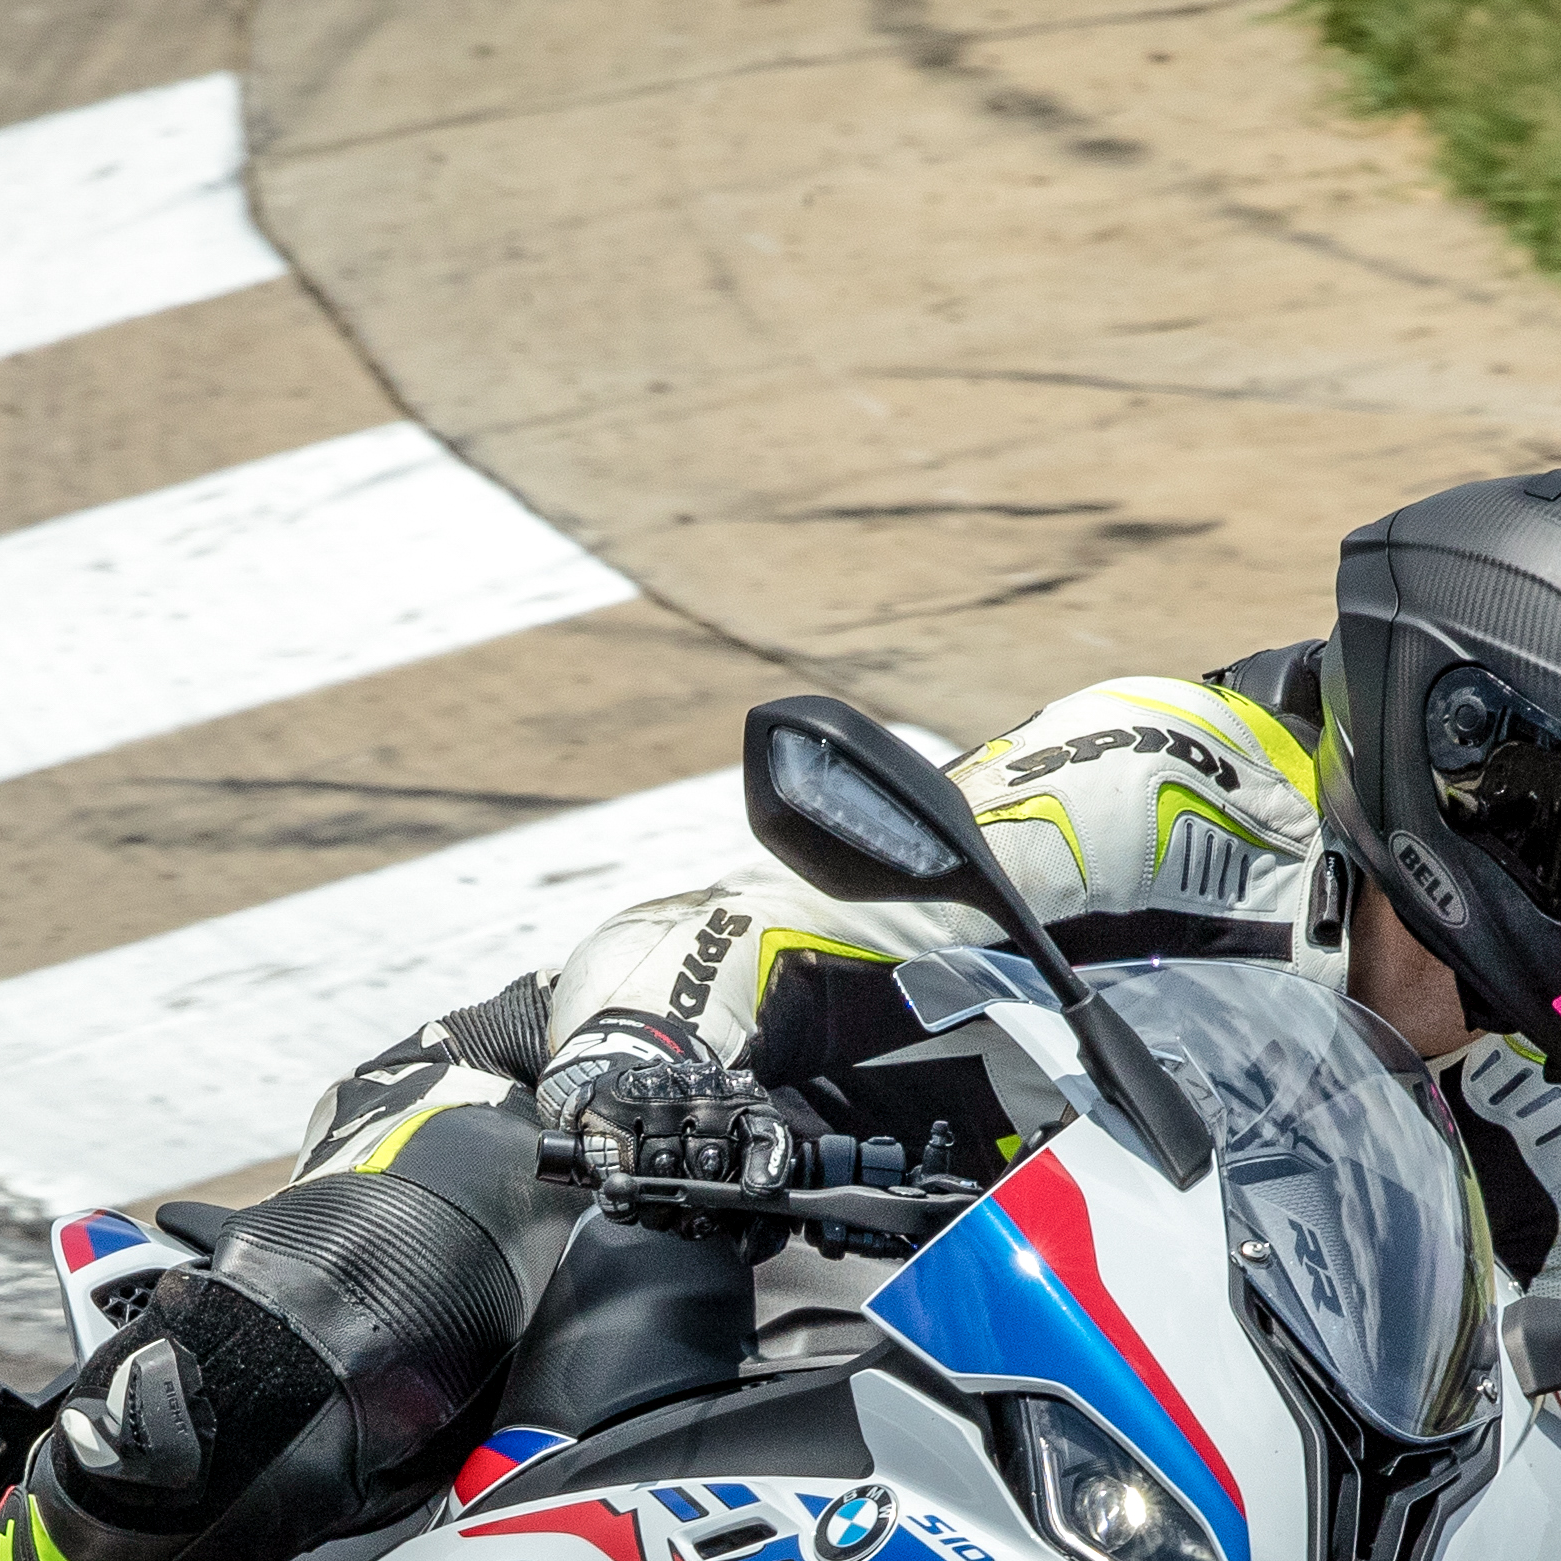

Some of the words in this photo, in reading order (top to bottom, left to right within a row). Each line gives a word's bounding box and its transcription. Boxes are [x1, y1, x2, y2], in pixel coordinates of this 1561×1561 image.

[1005, 726, 1241, 794] SPIDI
[1399, 844, 1454, 917] BELL
[666, 907, 753, 1037] SPIDI
[1287, 1217, 1346, 1319] RR
[164, 1381, 189, 1436] RIGHT
[842, 1484, 895, 1521] BMW
